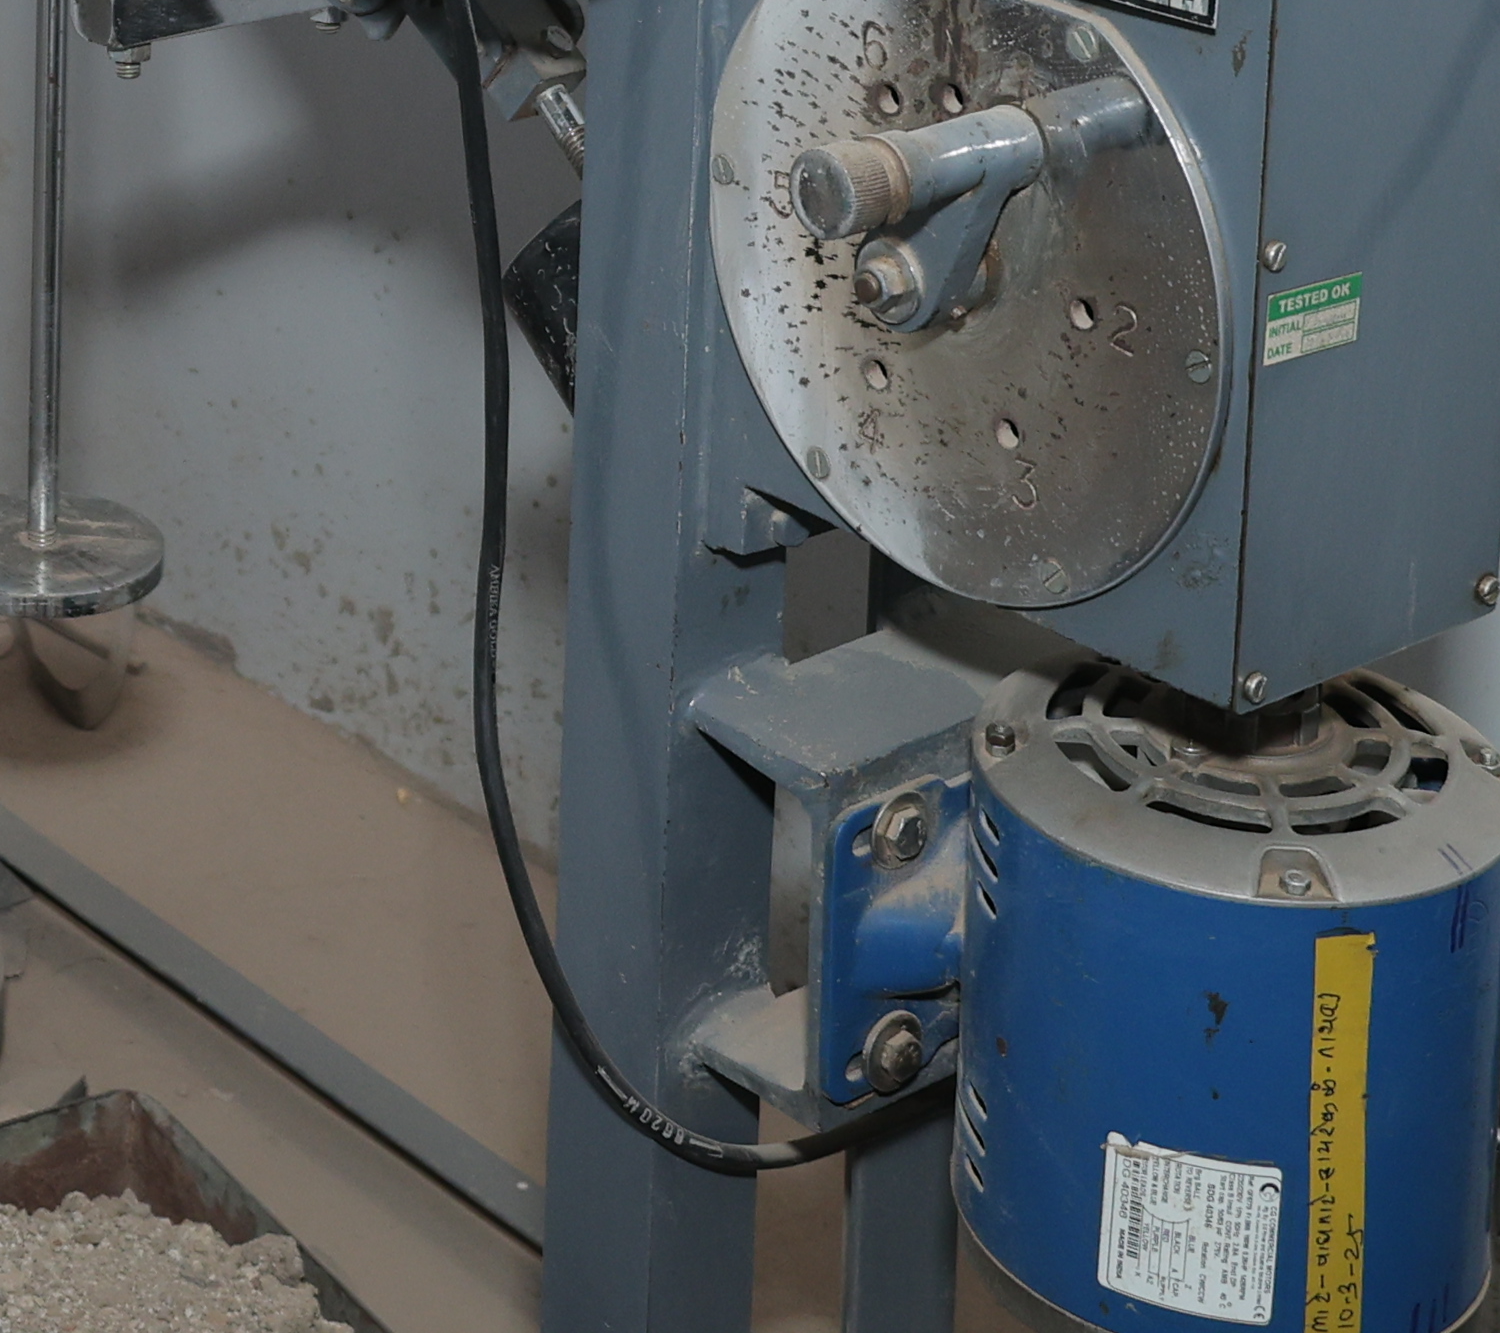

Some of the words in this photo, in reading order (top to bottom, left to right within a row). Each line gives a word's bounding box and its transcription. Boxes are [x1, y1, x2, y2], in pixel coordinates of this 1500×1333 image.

[860, 20, 888, 71] 6
[1279, 288, 1329, 314] TESTED
[1331, 281, 1351, 300] OK
[1108, 302, 1139, 359] 2
[1268, 320, 1301, 338] INITIAL
[1267, 342, 1292, 360] DATE
[1010, 458, 1040, 511] 3
[1265, 1218, 1277, 1263] COMMERCIAL
[1264, 1265, 1273, 1294] MOTORS
